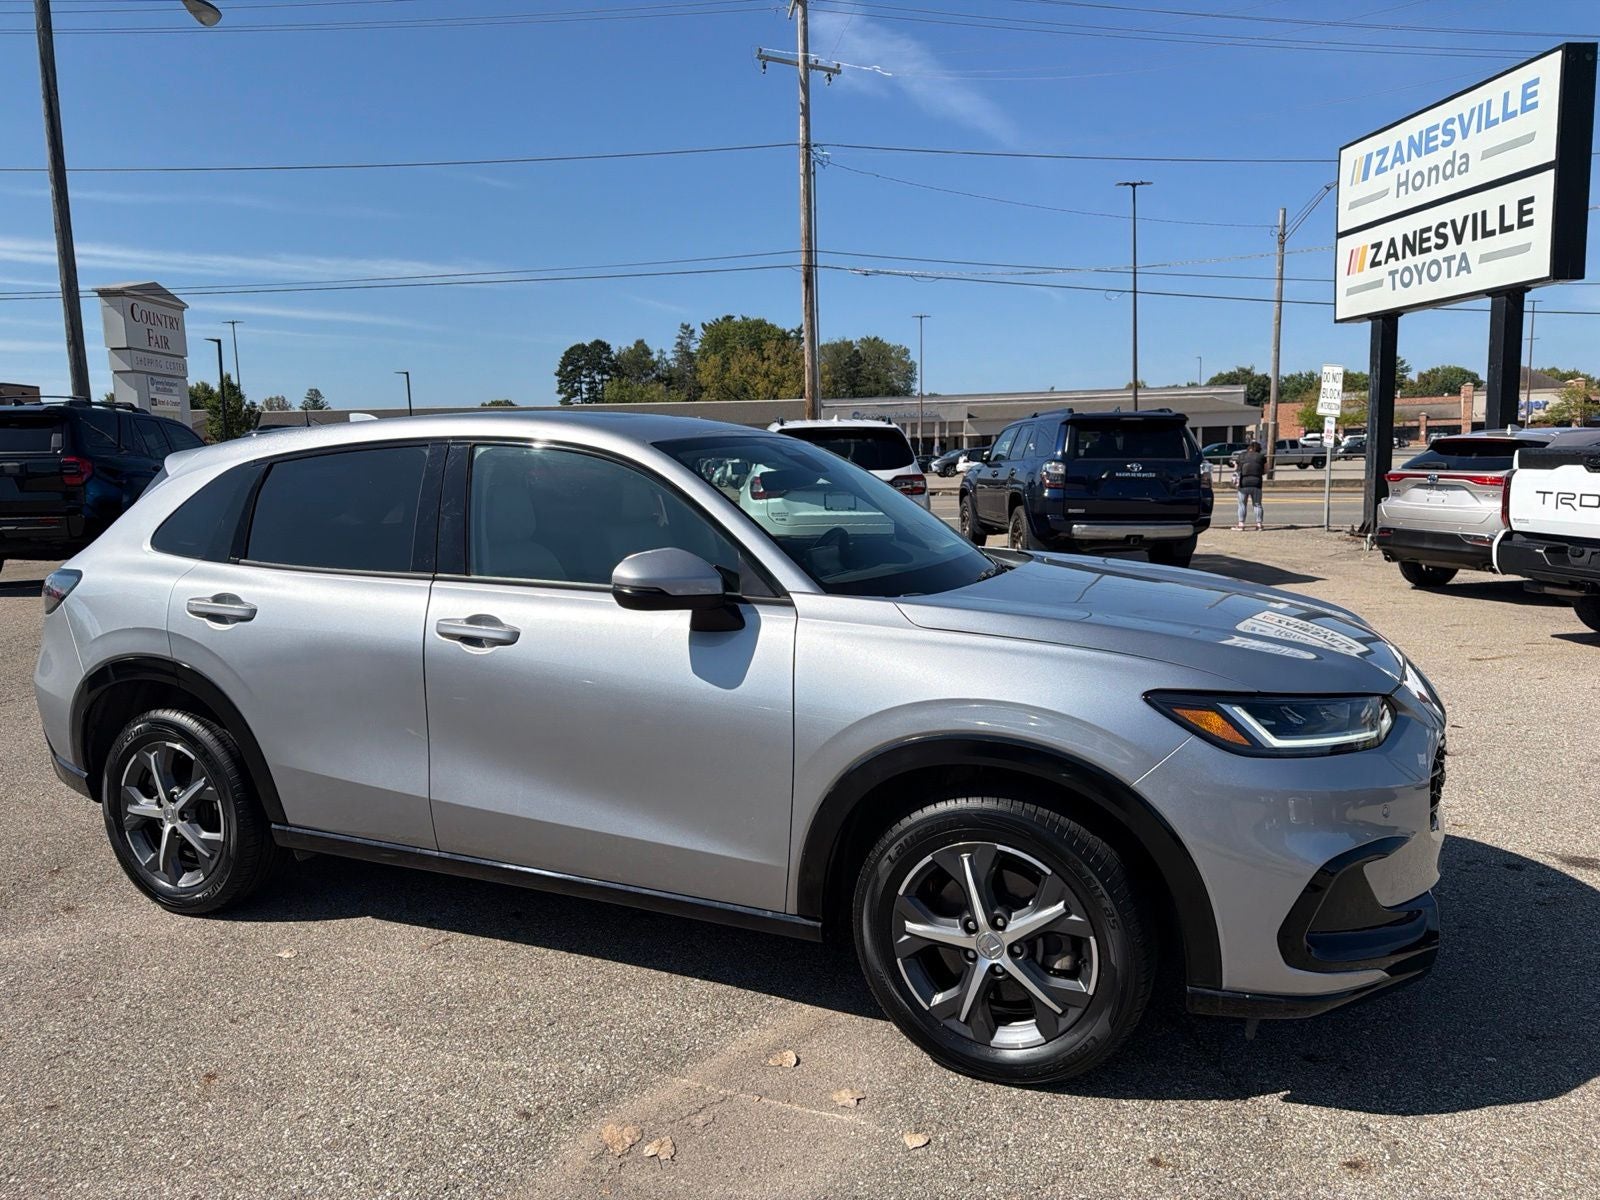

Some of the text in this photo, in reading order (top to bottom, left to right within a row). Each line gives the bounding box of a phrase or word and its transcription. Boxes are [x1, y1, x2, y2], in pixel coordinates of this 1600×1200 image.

[1374, 77, 1541, 176] ZANESVILLE
[1396, 151, 1470, 199] Honda
[1369, 195, 1536, 269] ZANESVILLE
[1388, 251, 1472, 291] TOYOTA
[130, 302, 180, 331] COUNTRY
[147, 328, 171, 350] FAIR
[1322, 371, 1342, 384] DO NOT
[1321, 387, 1341, 400] BLOCK
[1535, 490, 1600, 512] TRD
